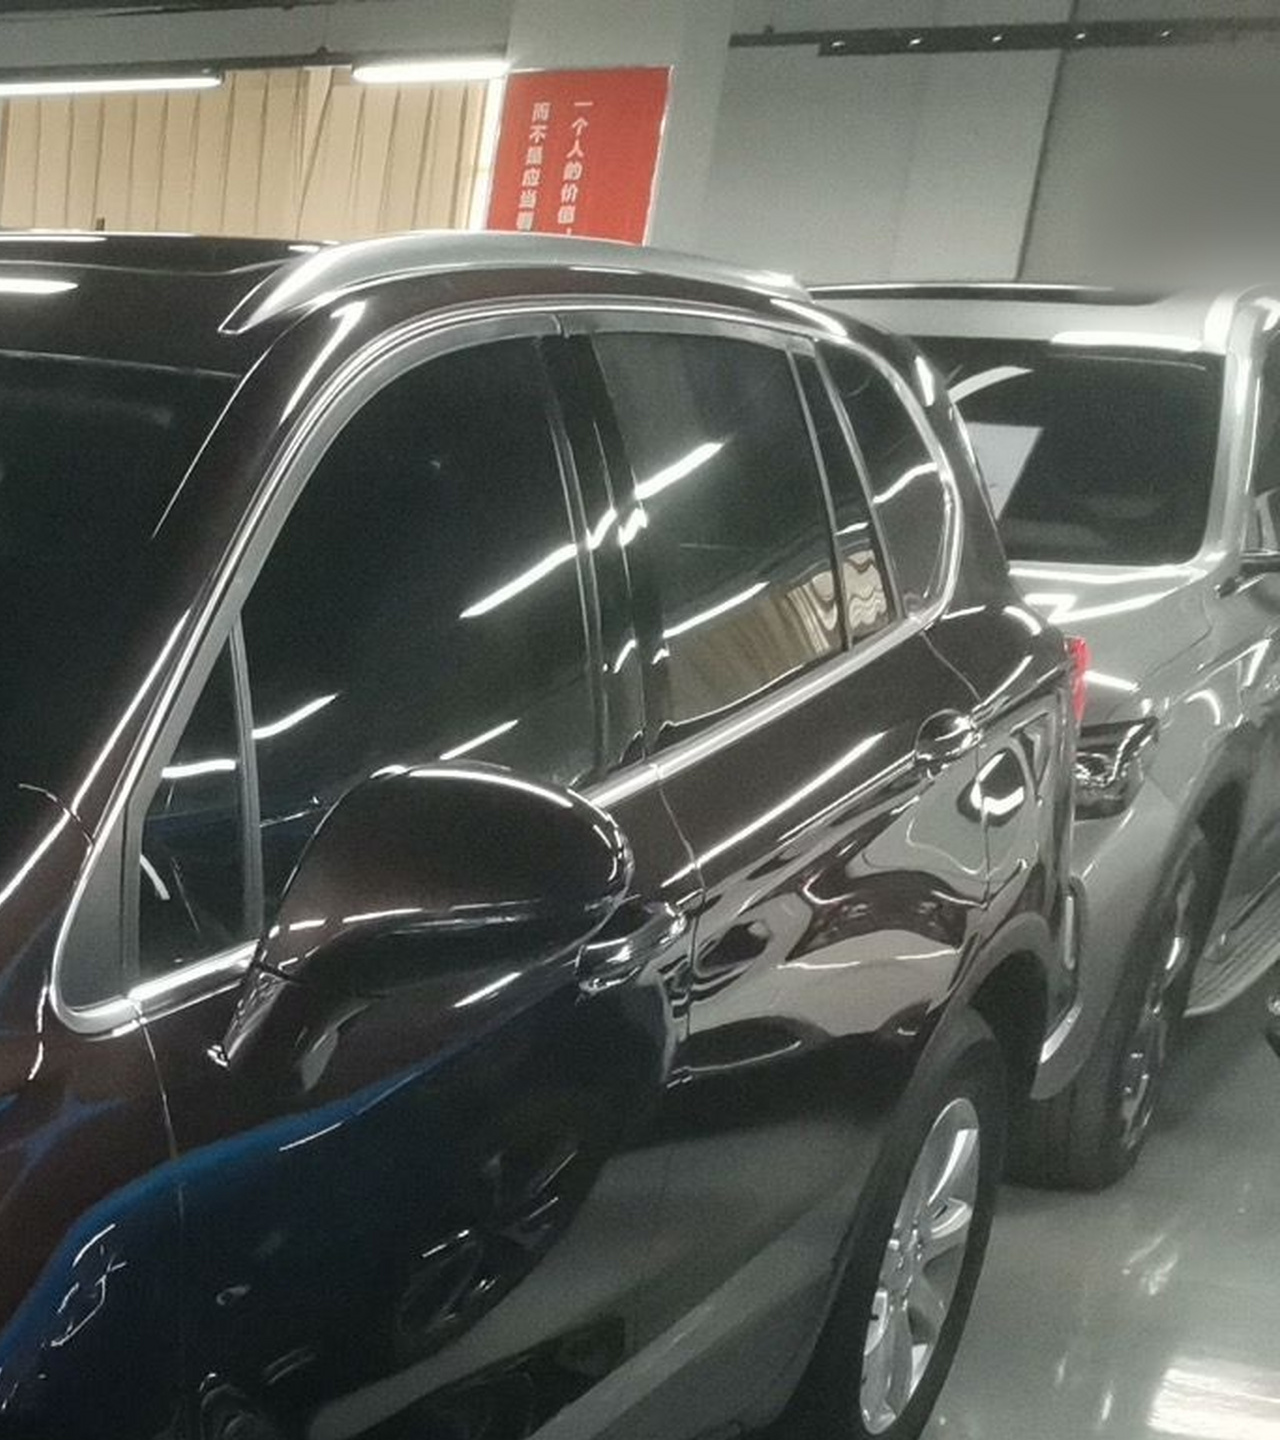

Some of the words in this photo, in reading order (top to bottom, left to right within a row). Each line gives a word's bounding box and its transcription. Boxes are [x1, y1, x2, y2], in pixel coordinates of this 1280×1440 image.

[557, 101, 594, 236] 一个人的价值
